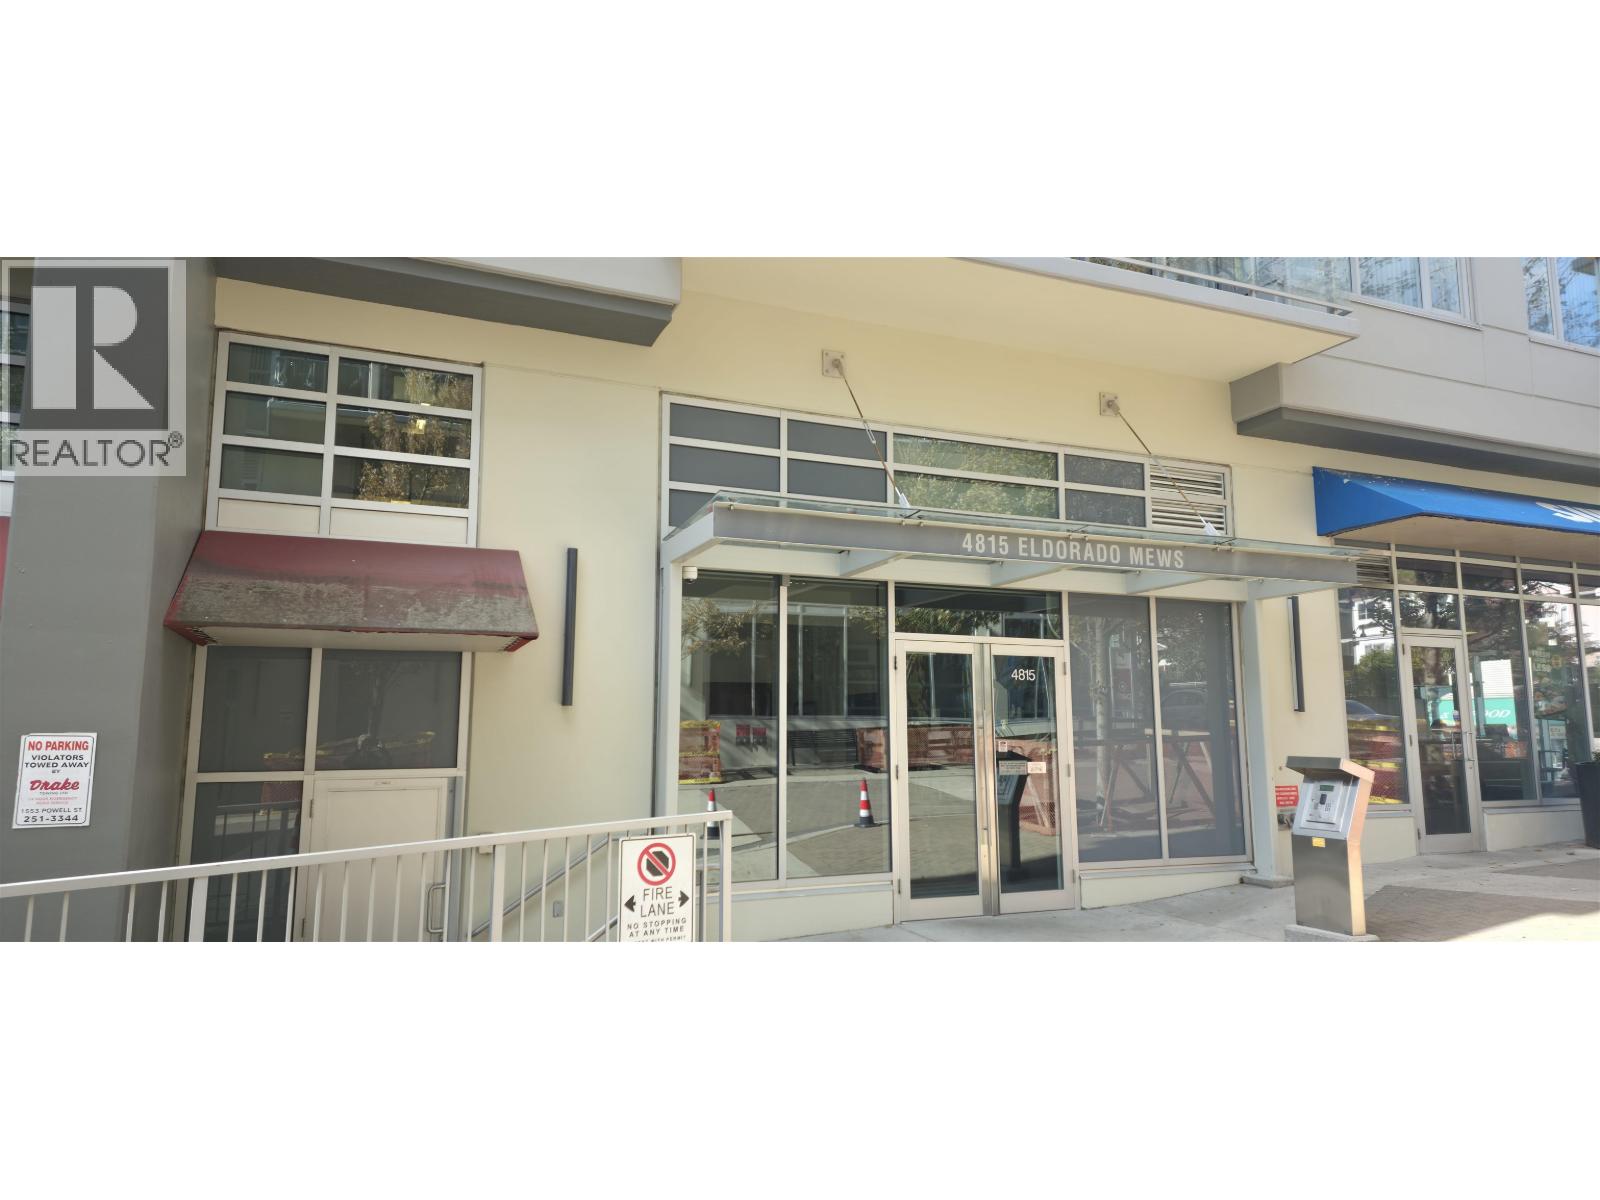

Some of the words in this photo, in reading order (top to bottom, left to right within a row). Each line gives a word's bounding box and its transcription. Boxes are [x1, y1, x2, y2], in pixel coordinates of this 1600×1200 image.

[962, 533, 1009, 555] 4815
[1018, 537, 1121, 564] ELDORADO
[1129, 549, 1184, 569] MEWS
[1011, 669, 1036, 681] 4815
[28, 741, 42, 751] NO
[45, 741, 89, 751] PARKING
[29, 778, 80, 791] Drake
[23, 815, 79, 823] 251-3344
[643, 886, 673, 901] FIRE
[640, 901, 675, 918] LANE
[627, 922, 639, 930] NO
[643, 917, 687, 929] STOPPING
[629, 930, 639, 938] AT
[643, 928, 661, 937] ANY
[665, 925, 685, 934] TIME
